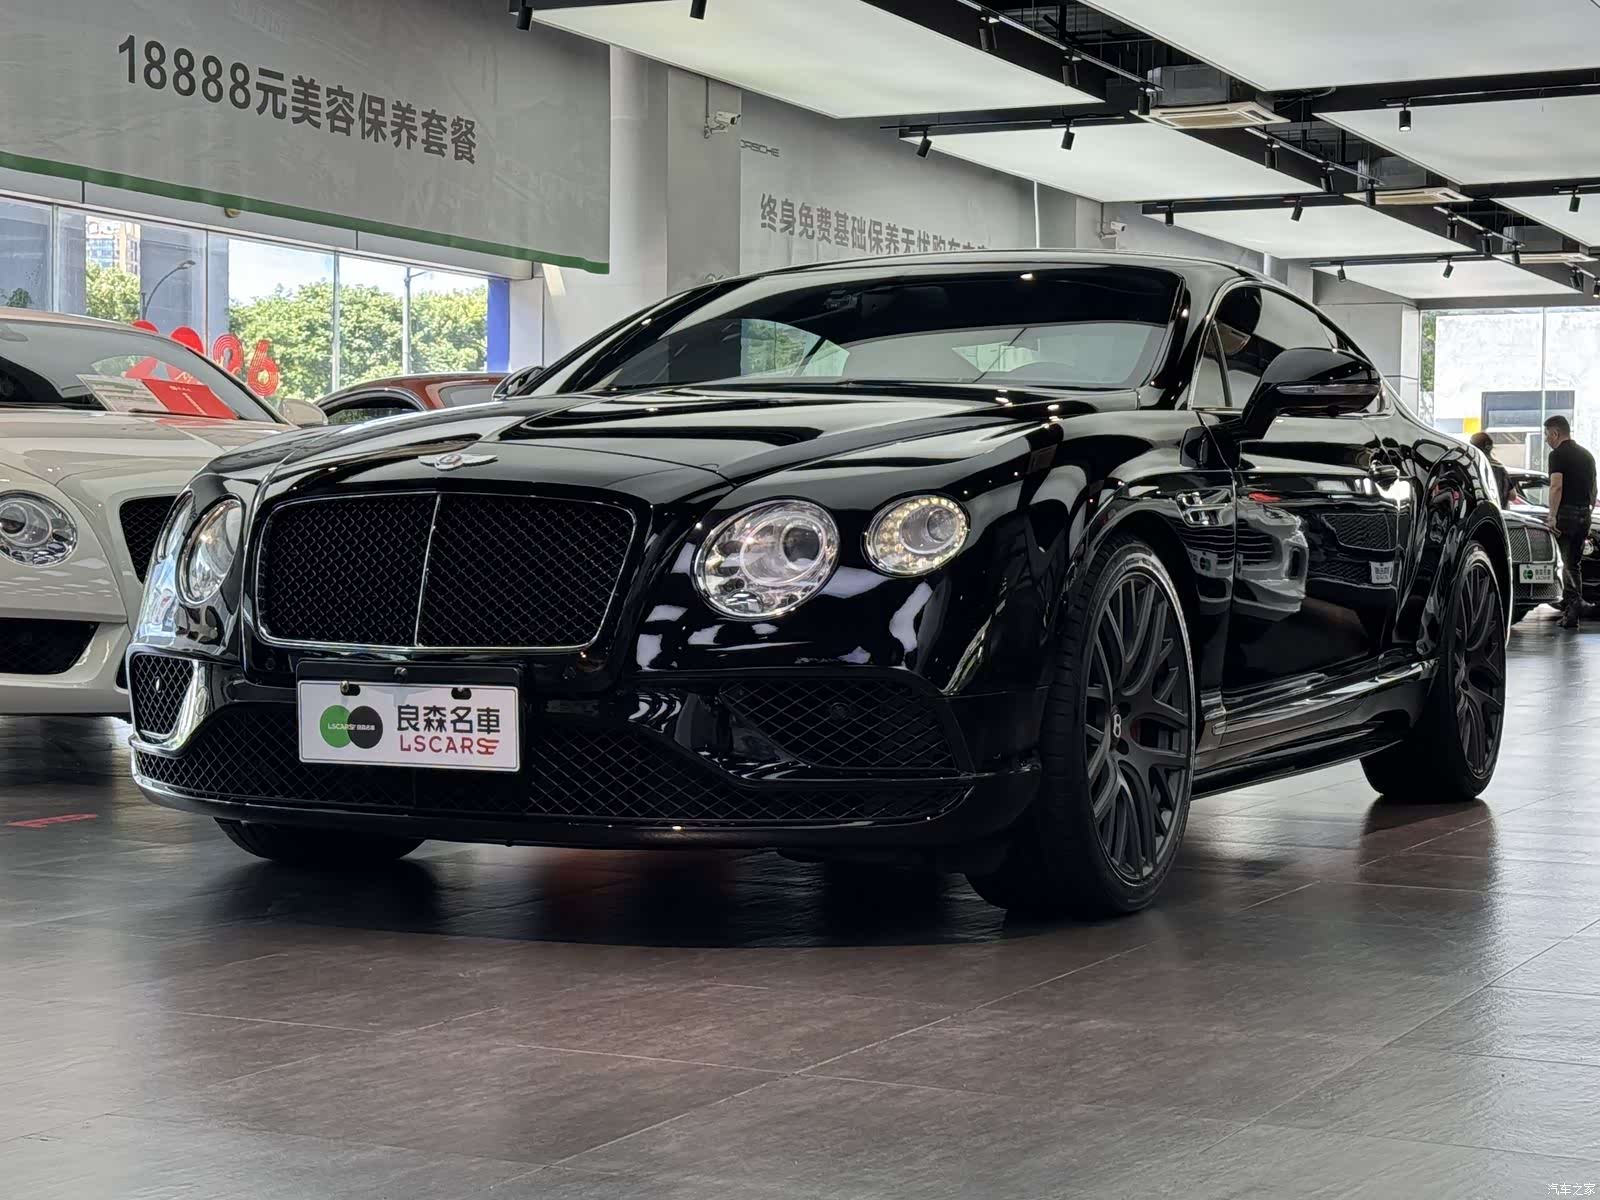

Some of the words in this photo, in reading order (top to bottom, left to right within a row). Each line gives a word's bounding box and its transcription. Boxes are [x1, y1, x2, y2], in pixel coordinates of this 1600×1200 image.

[118, 34, 476, 165] 18888元美容保养套餐
[760, 193, 989, 255] 终身免费基础保养无忧购
[397, 704, 501, 735] 良森名車
[400, 734, 500, 756] LSCARS
